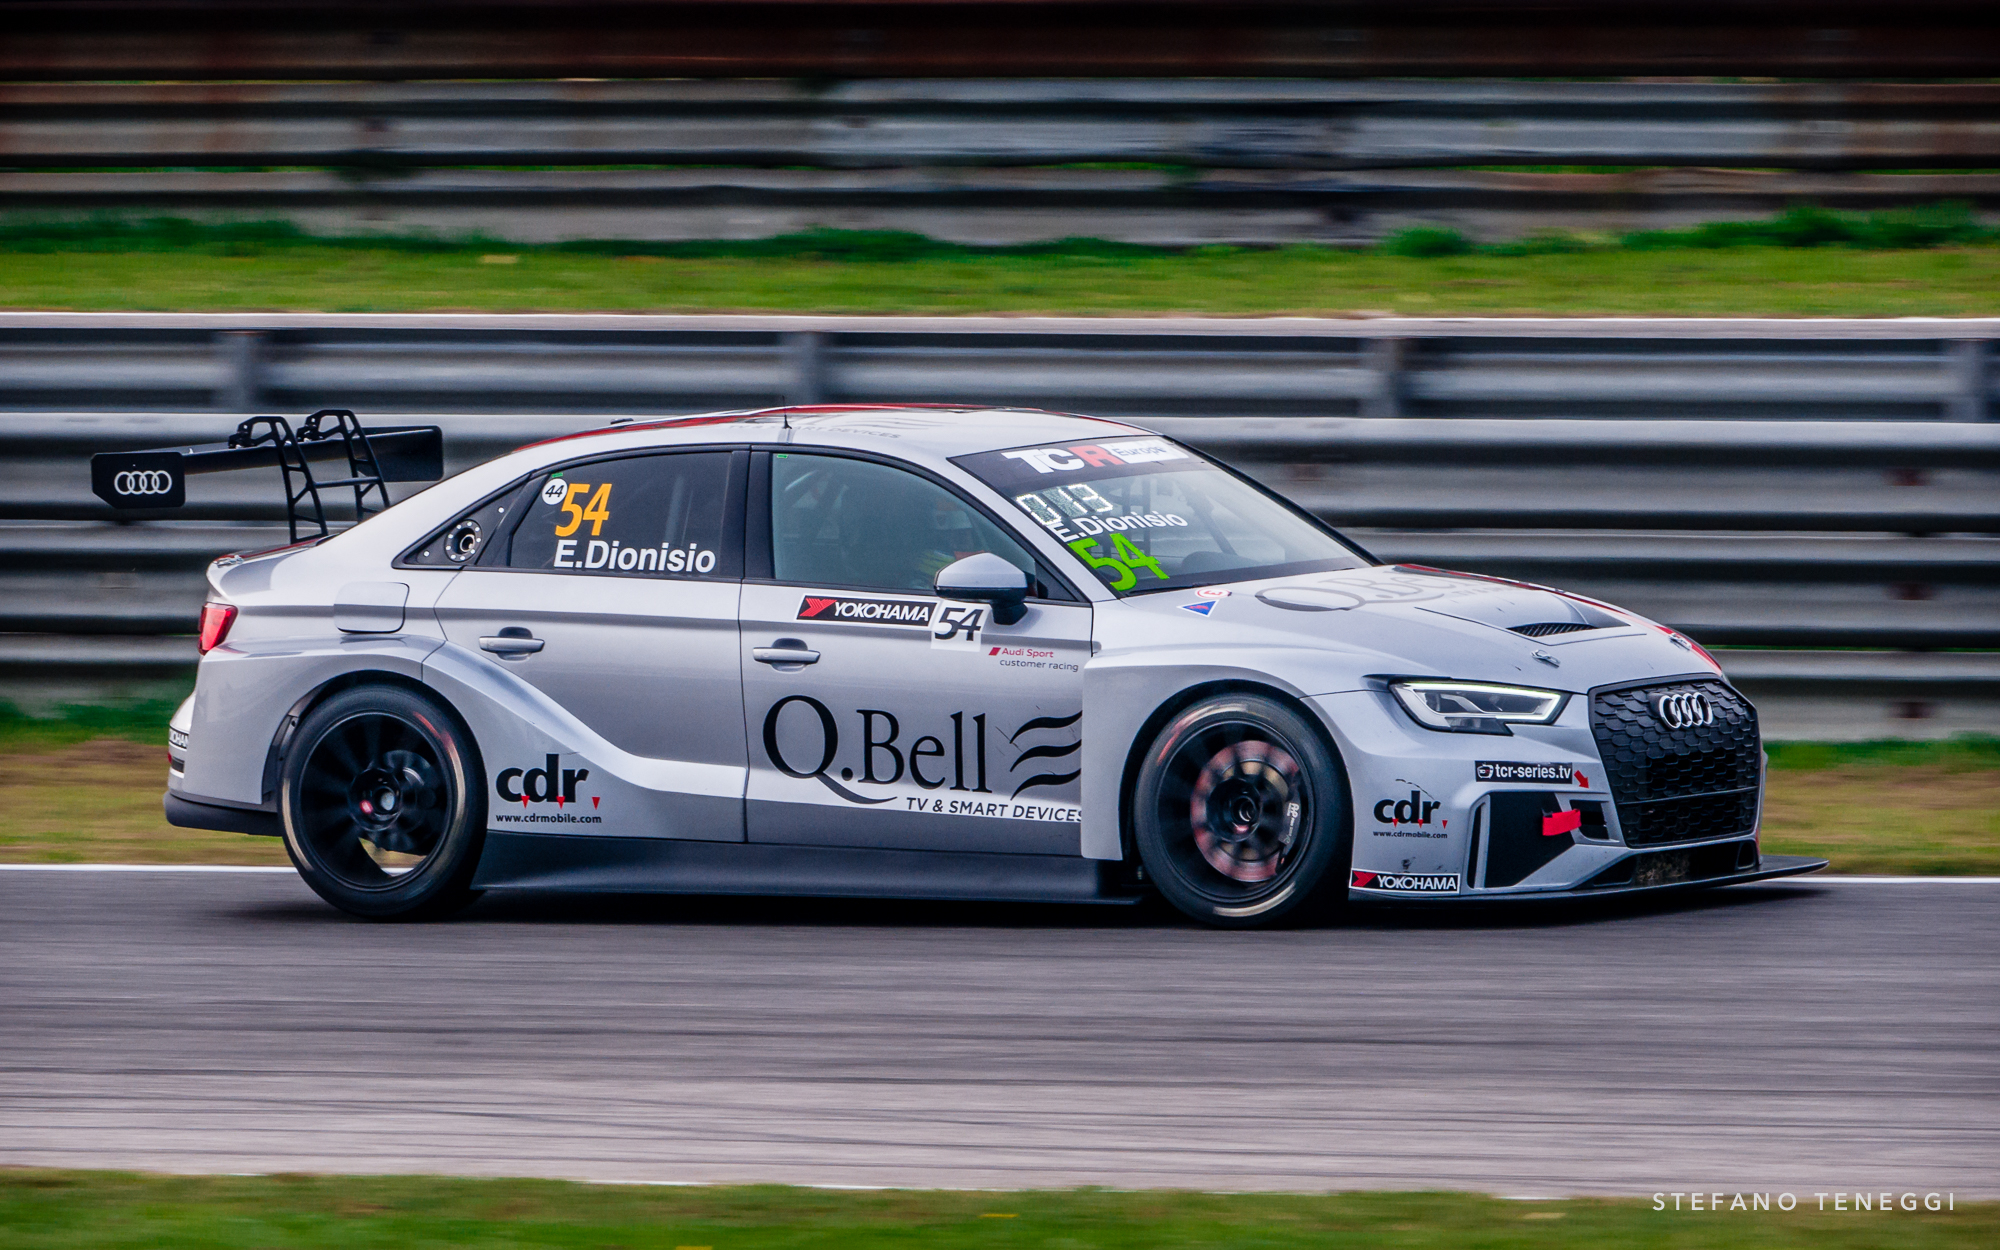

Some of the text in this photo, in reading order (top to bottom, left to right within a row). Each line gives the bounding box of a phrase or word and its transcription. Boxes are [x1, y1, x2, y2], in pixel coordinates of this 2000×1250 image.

[1001, 445, 1167, 474] TCR Europe
[545, 485, 564, 498] 44
[554, 483, 612, 537] 54
[1046, 510, 1189, 543] E.Dionisio
[553, 539, 716, 573] E.Dionisio
[1067, 532, 1170, 592] 54
[833, 601, 930, 622] YOKOHAMA
[934, 607, 984, 642] 54
[1001, 647, 1054, 659] Audi Sport
[999, 659, 1079, 673] customer racing
[762, 695, 993, 805] Q.Bell
[495, 753, 590, 804] cdr
[1495, 763, 1572, 779] tcr-series.tv
[495, 812, 602, 824] www.cdrmobile.com
[906, 797, 929, 811] TV
[932, 799, 944, 813] &
[949, 800, 1008, 817] SMART
[1373, 790, 1441, 825] cdr
[1372, 830, 1448, 839] www.cdrmobile.com
[1377, 874, 1457, 890] YOKOHAMA
